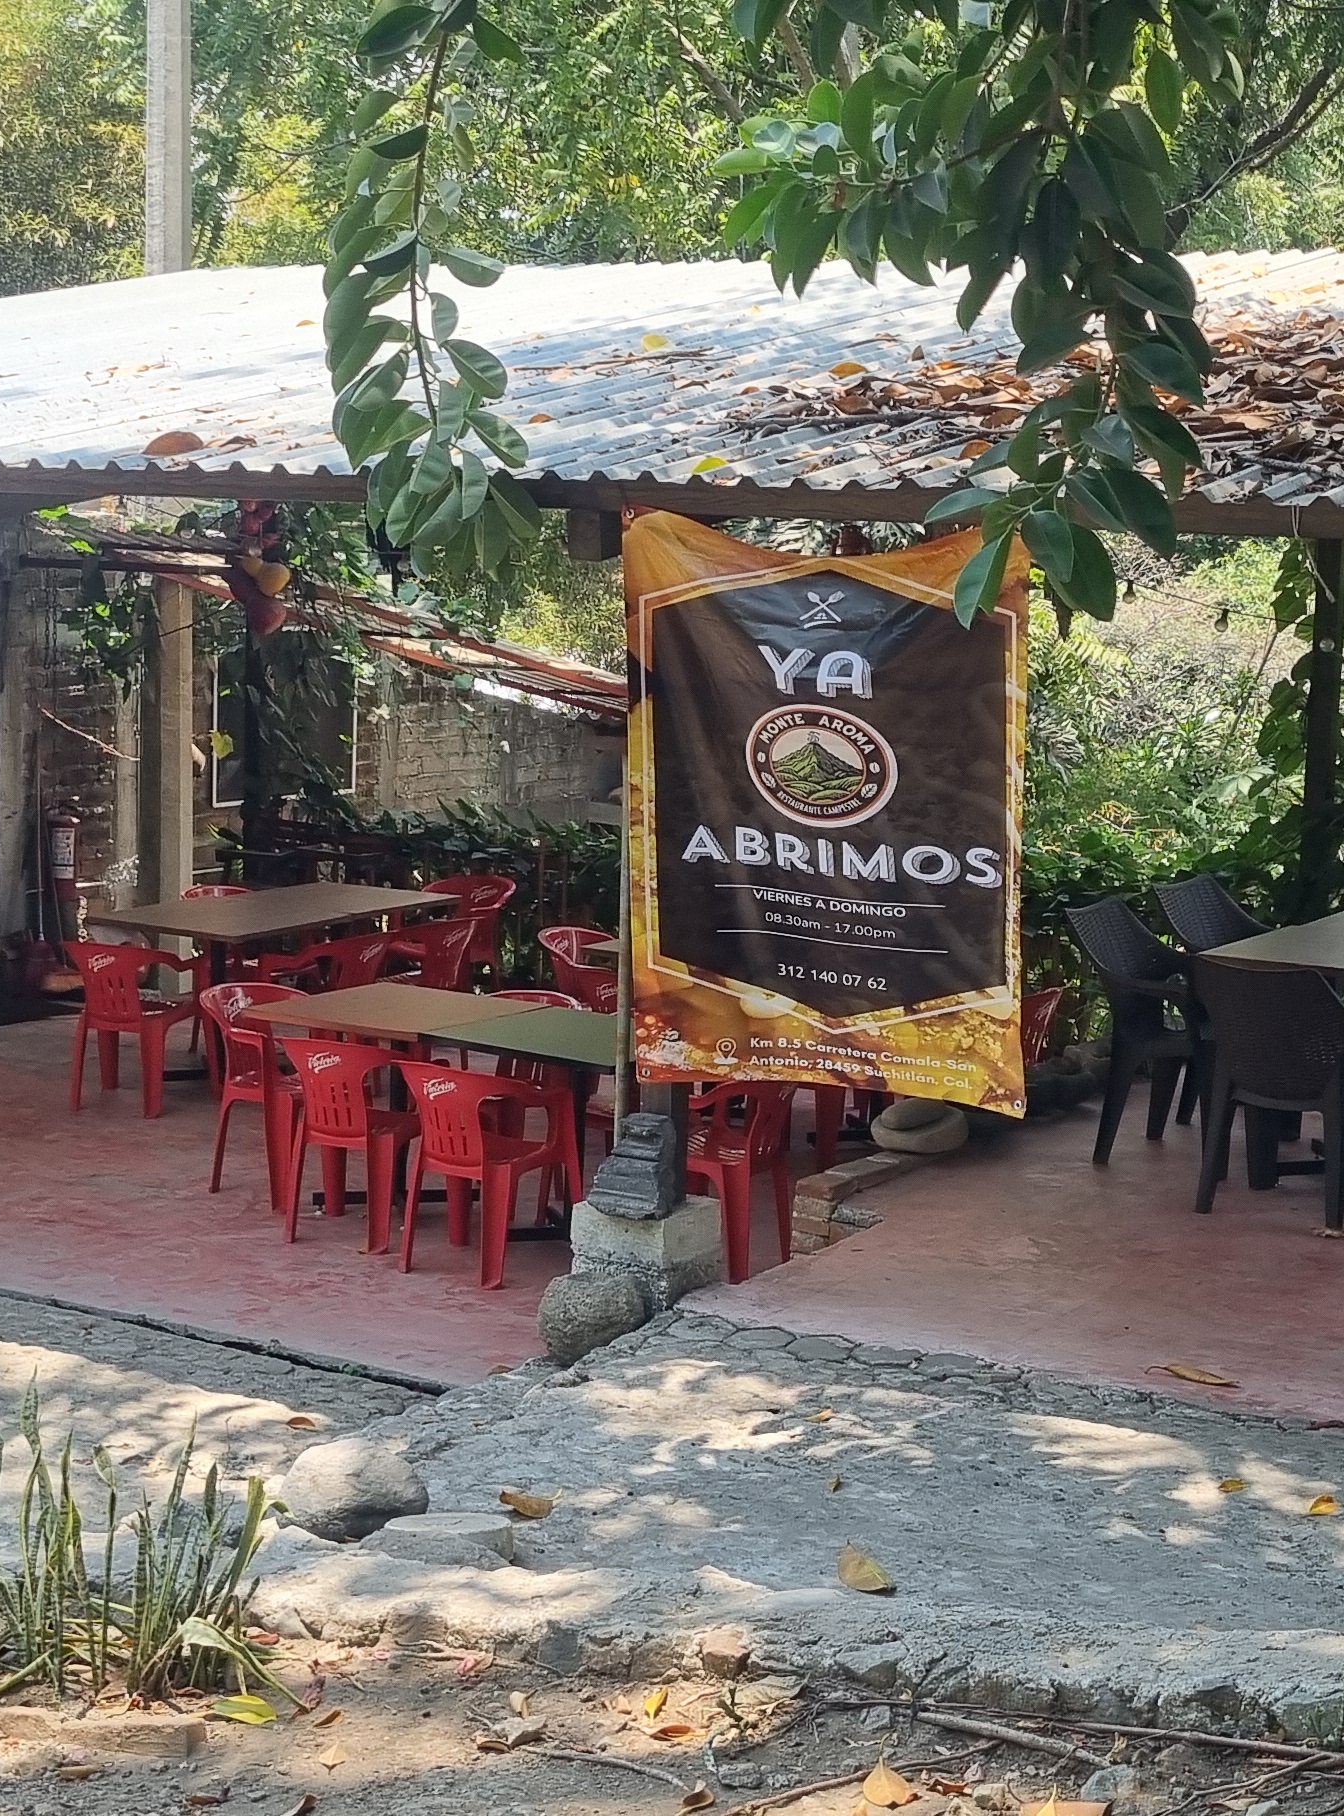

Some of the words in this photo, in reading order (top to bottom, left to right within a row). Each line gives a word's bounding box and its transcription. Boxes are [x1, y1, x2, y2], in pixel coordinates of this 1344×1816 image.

[758, 644, 874, 698] YA
[758, 713, 805, 744] MONTE
[818, 715, 875, 755] AROMA
[776, 790, 822, 815] RESTAURANTE
[823, 797, 863, 815] CAMPESTRE
[681, 824, 1003, 889] ABRIMOS
[753, 889, 812, 907] VIERNES
[815, 900, 827, 910] A
[829, 901, 907, 918] DOMINGO
[765, 911, 821, 930] 08.30am
[834, 922, 896, 940] 17.00pm
[777, 963, 805, 979] 312
[810, 969, 838, 984] 140
[842, 974, 862, 987] 07
[867, 977, 887, 991] 62
[750, 1038, 773, 1049] Km
[777, 1037, 802, 1049] 8.5
[805, 1040, 877, 1061] Carretera
[749, 1055, 812, 1069] Antonio,
[816, 1058, 861, 1073] 28459
